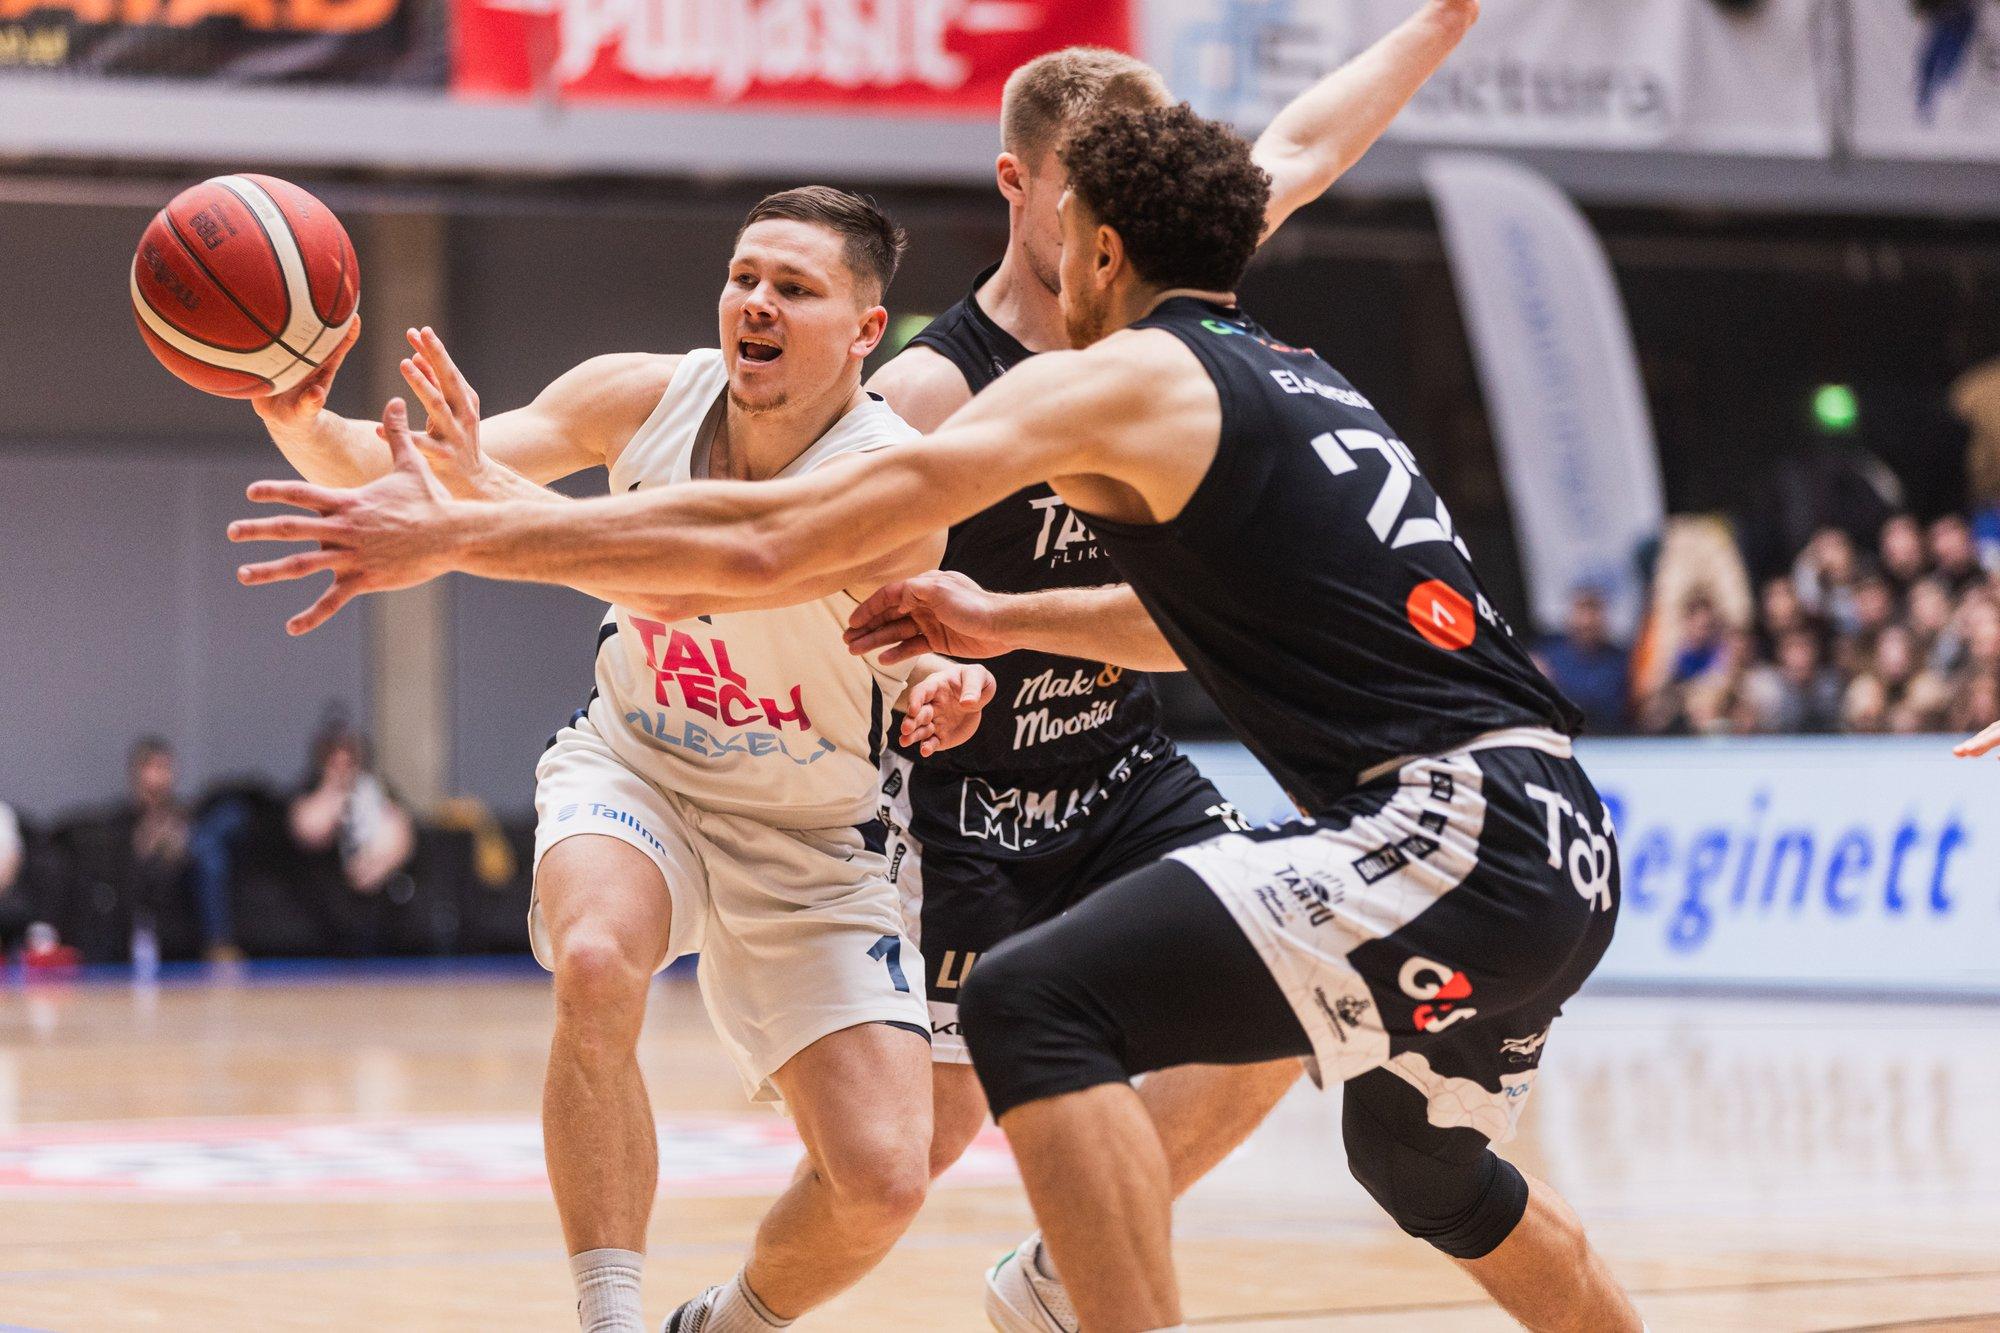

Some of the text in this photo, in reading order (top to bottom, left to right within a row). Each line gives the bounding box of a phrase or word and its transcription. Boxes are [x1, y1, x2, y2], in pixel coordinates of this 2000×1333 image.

[628, 614, 747, 691] TAL
[647, 665, 813, 732] TECH
[588, 802, 667, 857] Tallinn
[1273, 864, 1335, 928] TARTU
[1600, 792, 1968, 954] eginett
